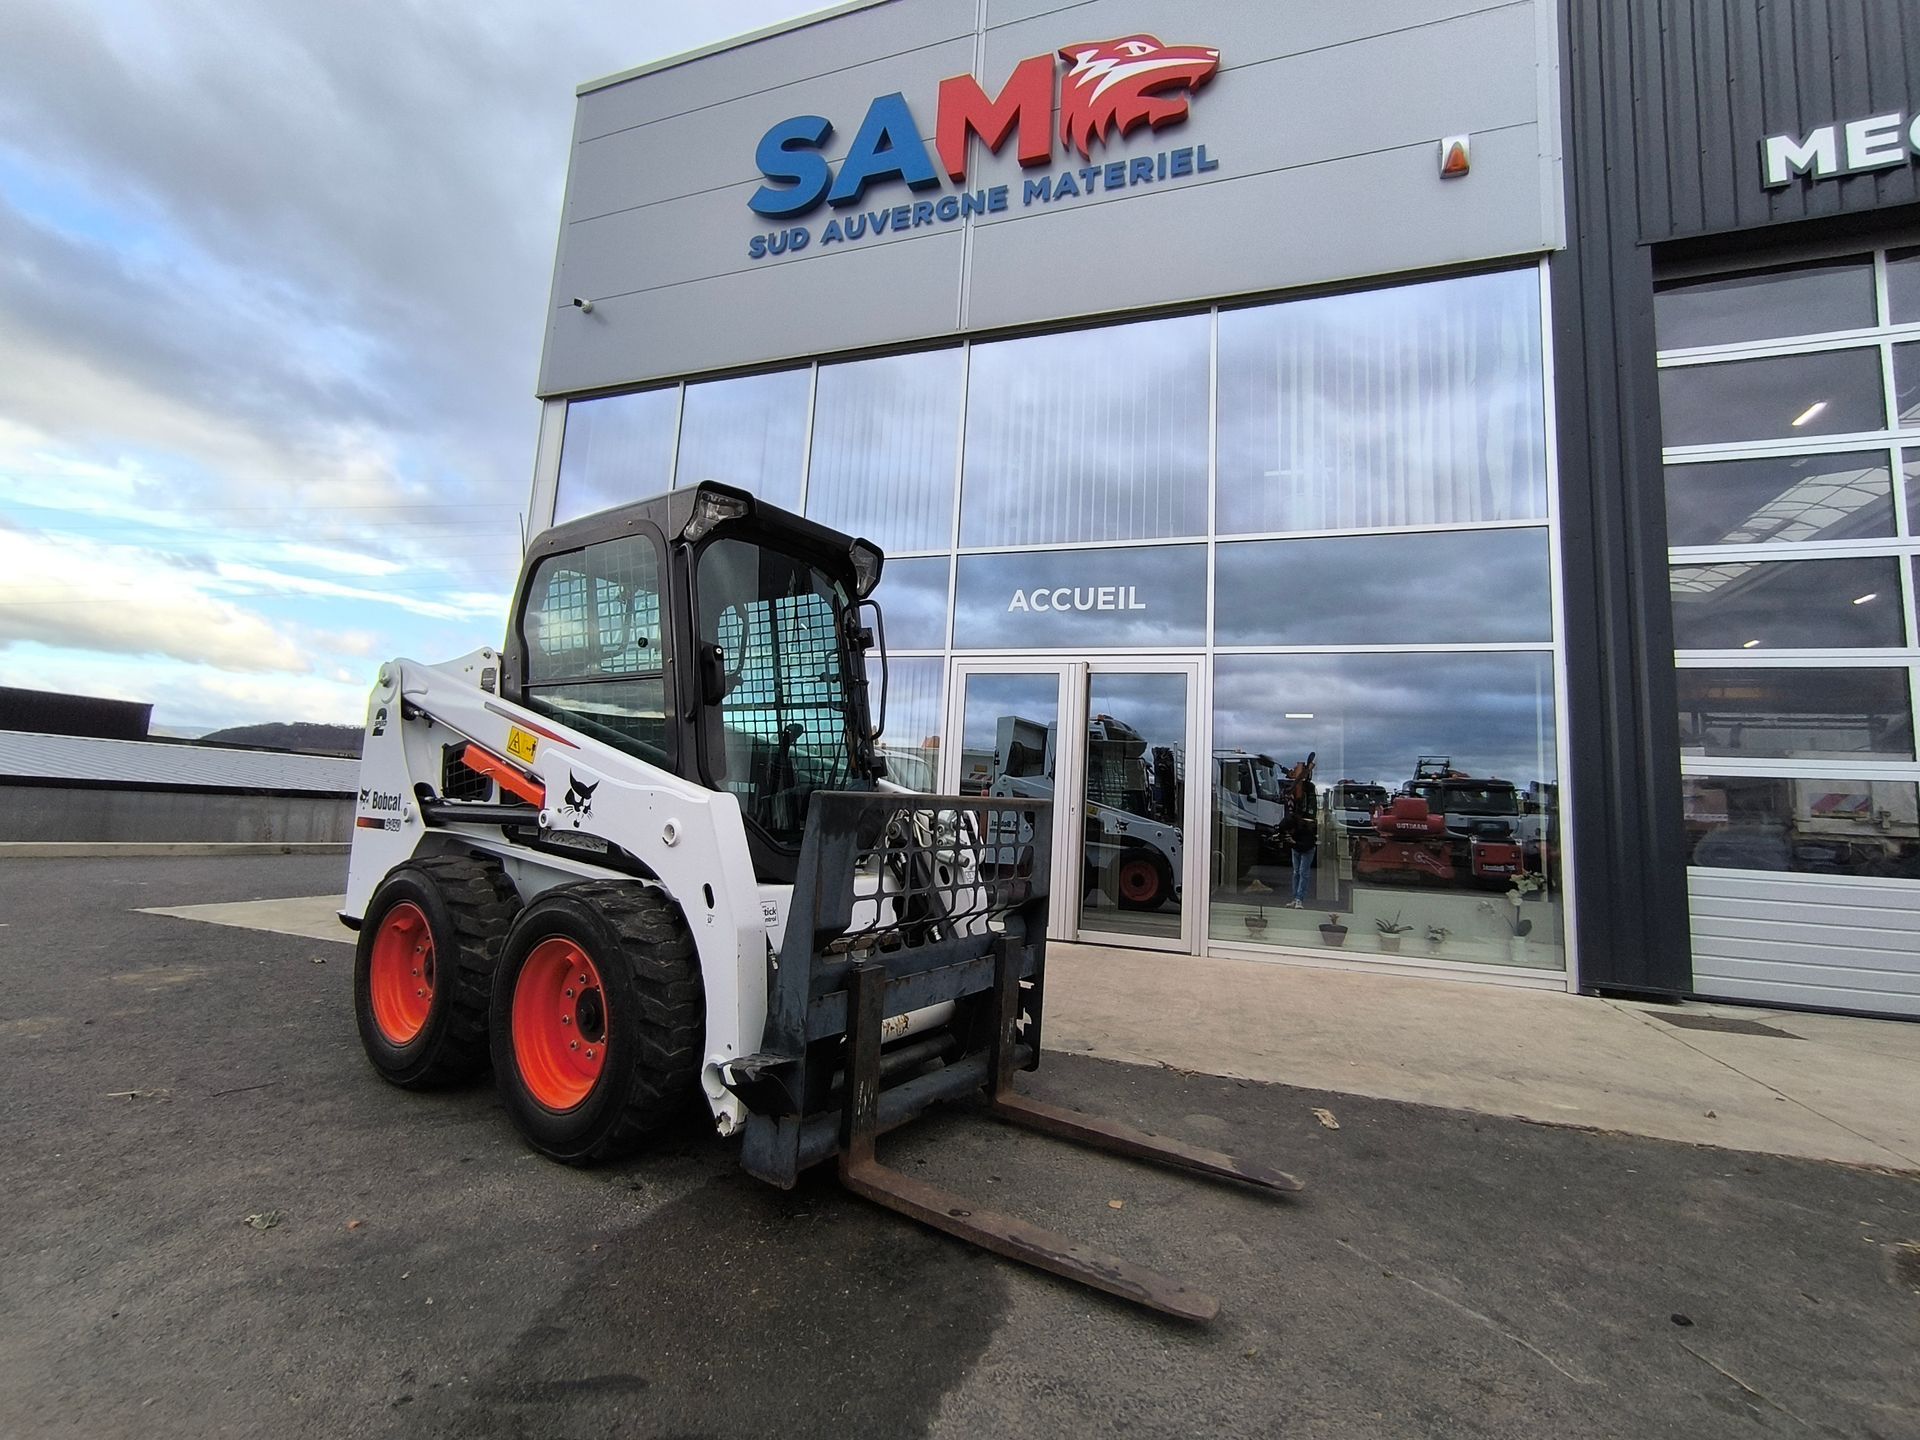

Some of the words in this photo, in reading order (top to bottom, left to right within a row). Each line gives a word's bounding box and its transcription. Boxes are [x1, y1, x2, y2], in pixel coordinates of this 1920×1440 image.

[747, 53, 1054, 219] SAM
[1765, 113, 1920, 184] ME
[749, 227, 810, 259] SUD
[820, 184, 1008, 245] AUVERGNE
[1023, 144, 1219, 206] MATERIEL
[1007, 586, 1146, 612] ACCUEIL
[372, 791, 402, 811] Bobcat
